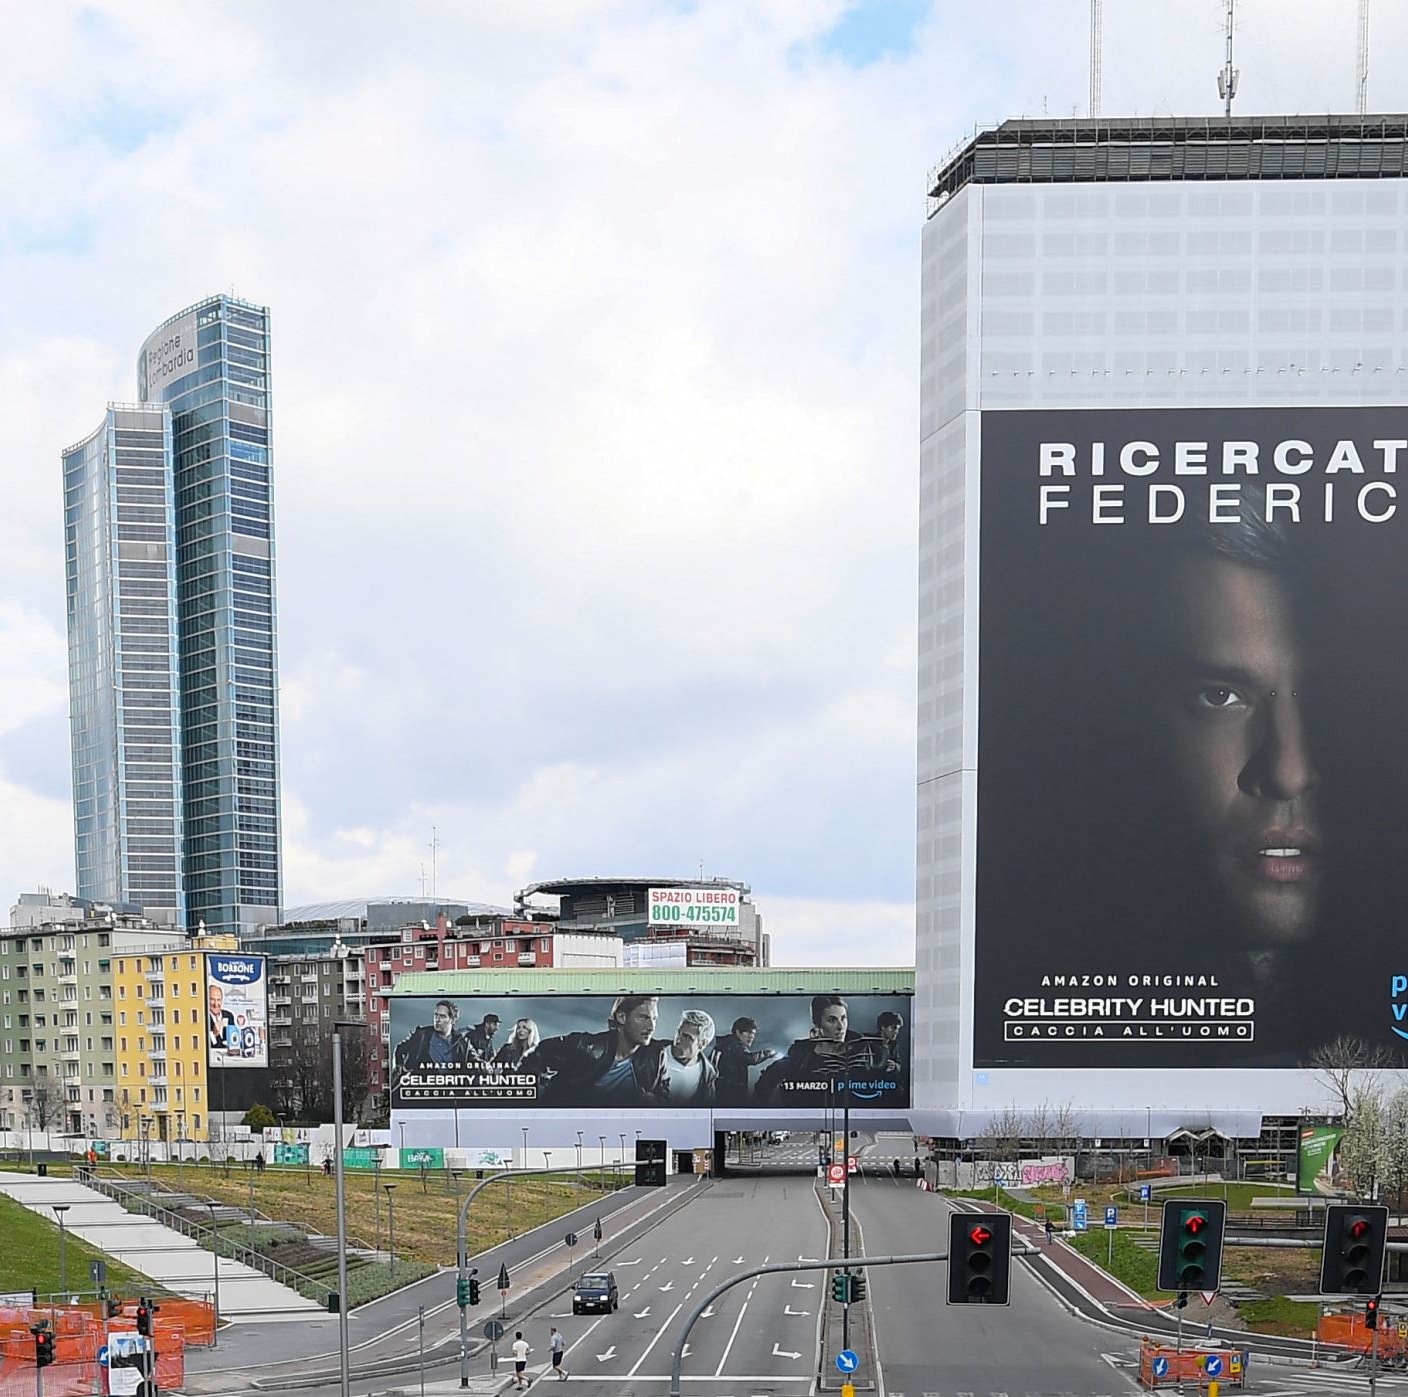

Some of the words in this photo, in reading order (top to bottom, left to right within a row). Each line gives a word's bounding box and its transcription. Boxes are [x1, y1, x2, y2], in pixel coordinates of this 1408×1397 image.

[652, 891, 692, 903] SPAZIO
[696, 893, 736, 904] LIBERO
[652, 905, 736, 922] 800-475574
[217, 962, 255, 974] BORBONE
[1041, 975, 1118, 986] AMAZON
[1128, 975, 1219, 986] ORIGINAL
[1003, 998, 1143, 1017] CELEBRITY
[1150, 998, 1255, 1017] HUNTED
[1013, 1026, 1104, 1037] CACCIA
[1122, 1026, 1248, 1037] ALL'UOMO
[400, 1074, 475, 1086] CELEBRITY
[479, 1074, 536, 1086] HUNTED
[784, 1081, 794, 1090] 13
[796, 1082, 828, 1090] MARZO
[837, 1080, 867, 1091] pime
[868, 1079, 896, 1090] video
[1107, 1208, 1115, 1218] P
